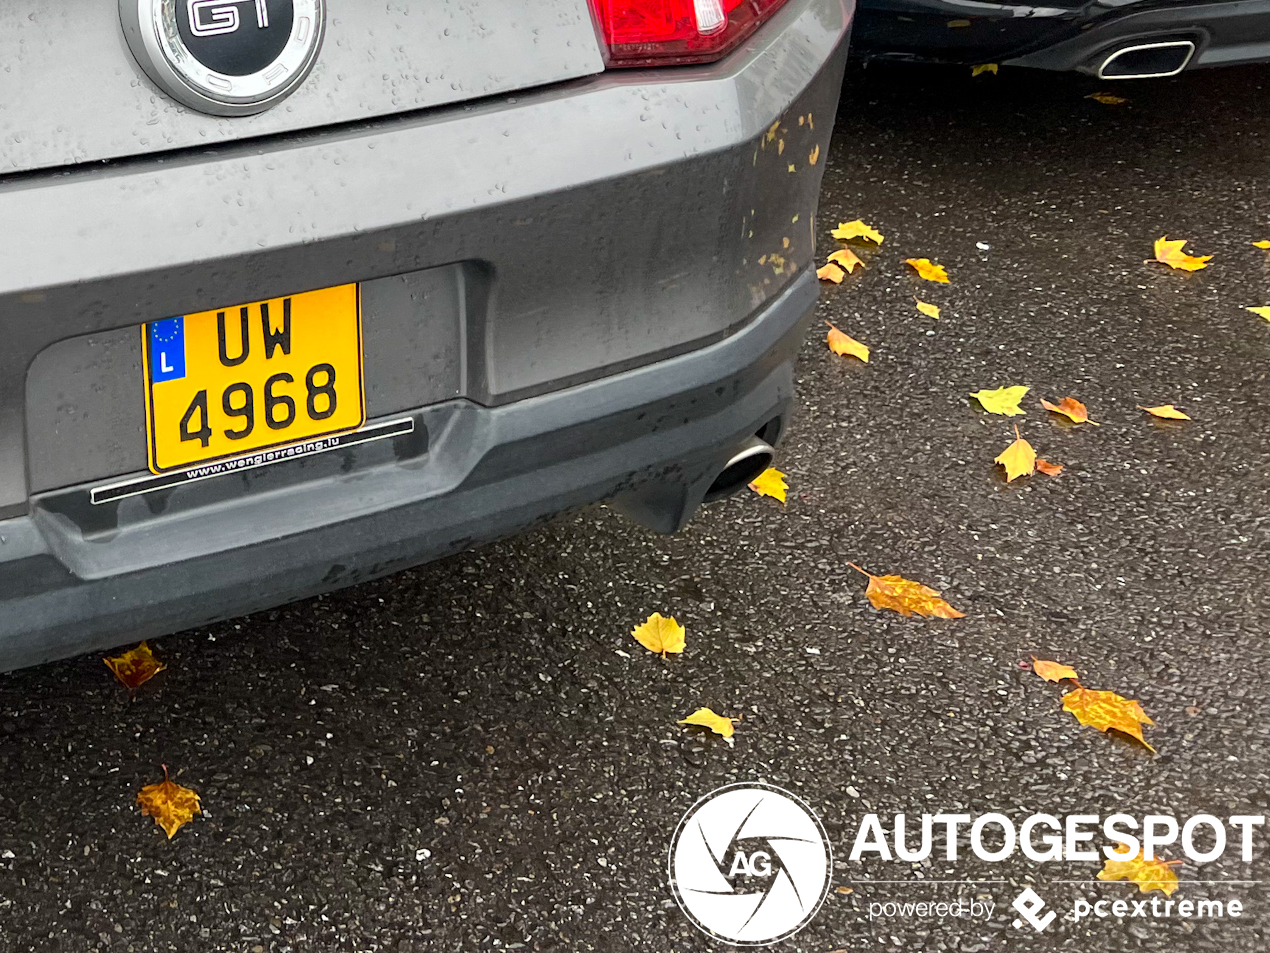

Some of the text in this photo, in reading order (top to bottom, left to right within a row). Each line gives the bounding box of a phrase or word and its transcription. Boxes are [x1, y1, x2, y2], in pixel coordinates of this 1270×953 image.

[160, 351, 174, 374] L
[216, 298, 292, 367] UW
[179, 363, 337, 447] 4968
